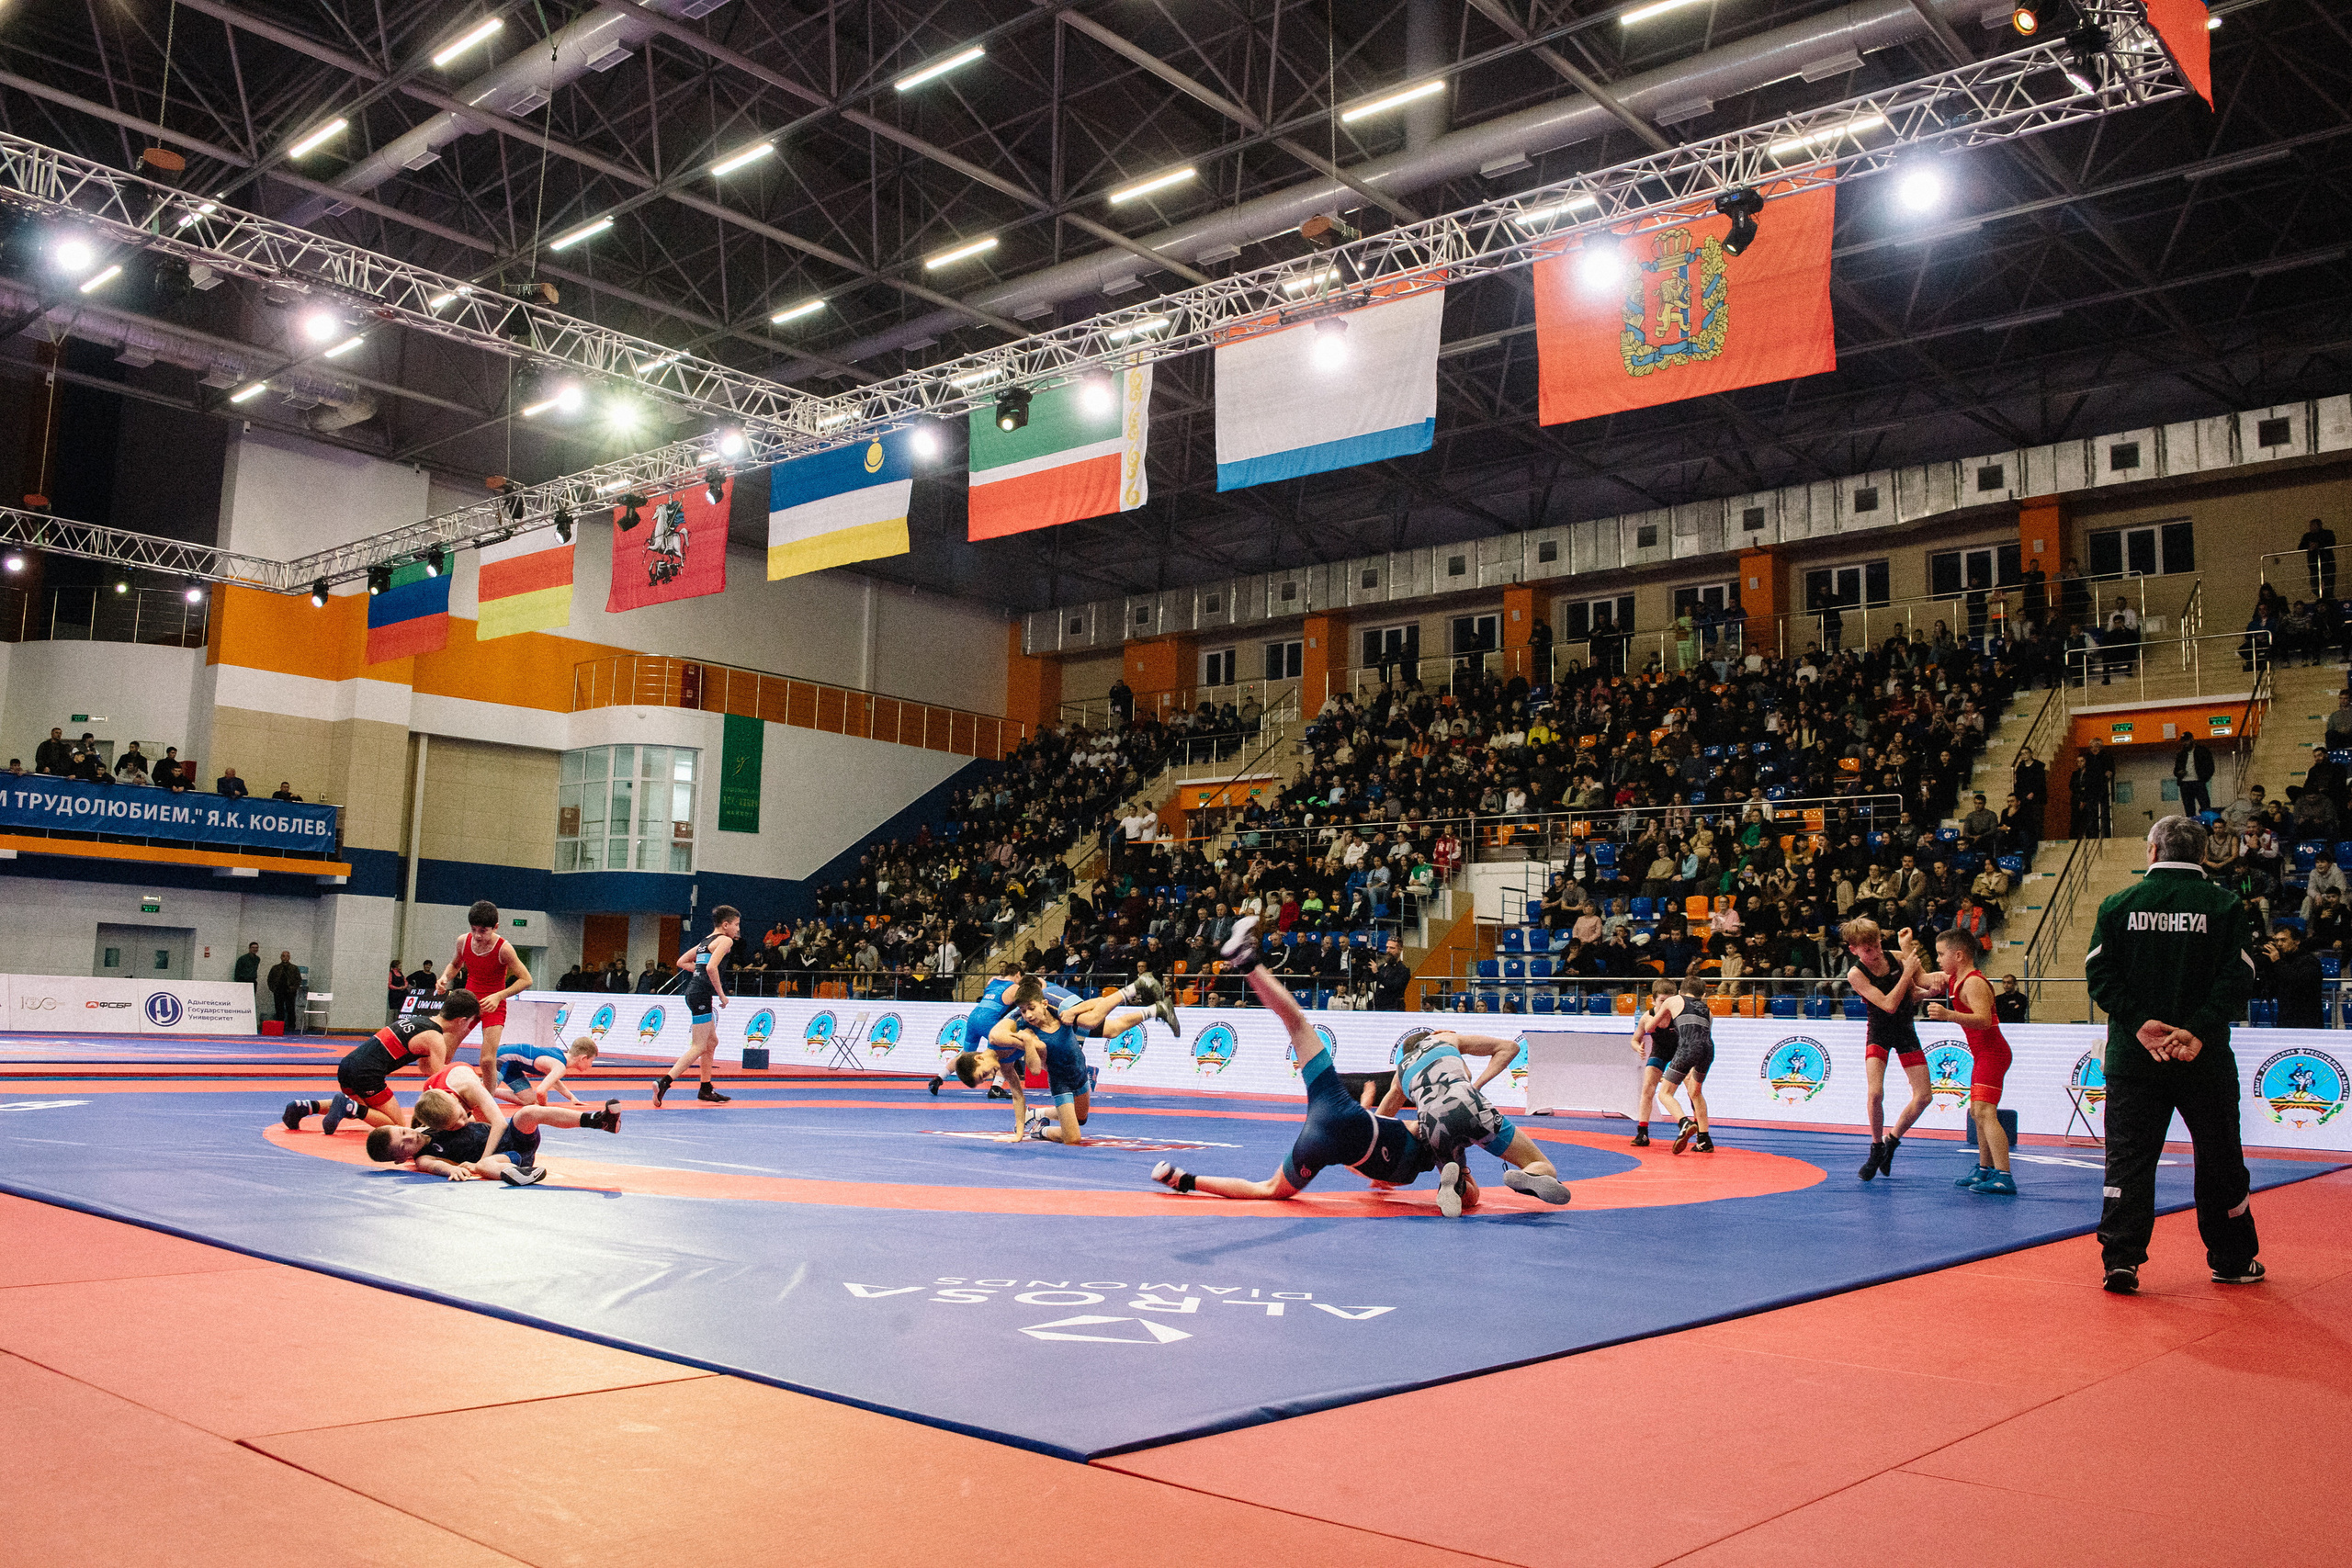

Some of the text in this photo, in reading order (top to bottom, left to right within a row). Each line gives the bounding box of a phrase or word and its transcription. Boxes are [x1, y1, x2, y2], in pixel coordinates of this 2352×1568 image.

[207, 810, 244, 829] Я.К.
[250, 814, 333, 837] КОБЛЕВ.
[2127, 911, 2208, 934] ADYGHEYA
[187, 998, 232, 1007] Адыгейский
[187, 1006, 252, 1015] Государственный
[2259, 1049, 2296, 1073] РЕСПУБЛИК
[2305, 1049, 2345, 1077] РЕСПУБЛИКА
[842, 1281, 1398, 1320] ALROSA
[933, 1277, 1312, 1301] DIAMONDS
